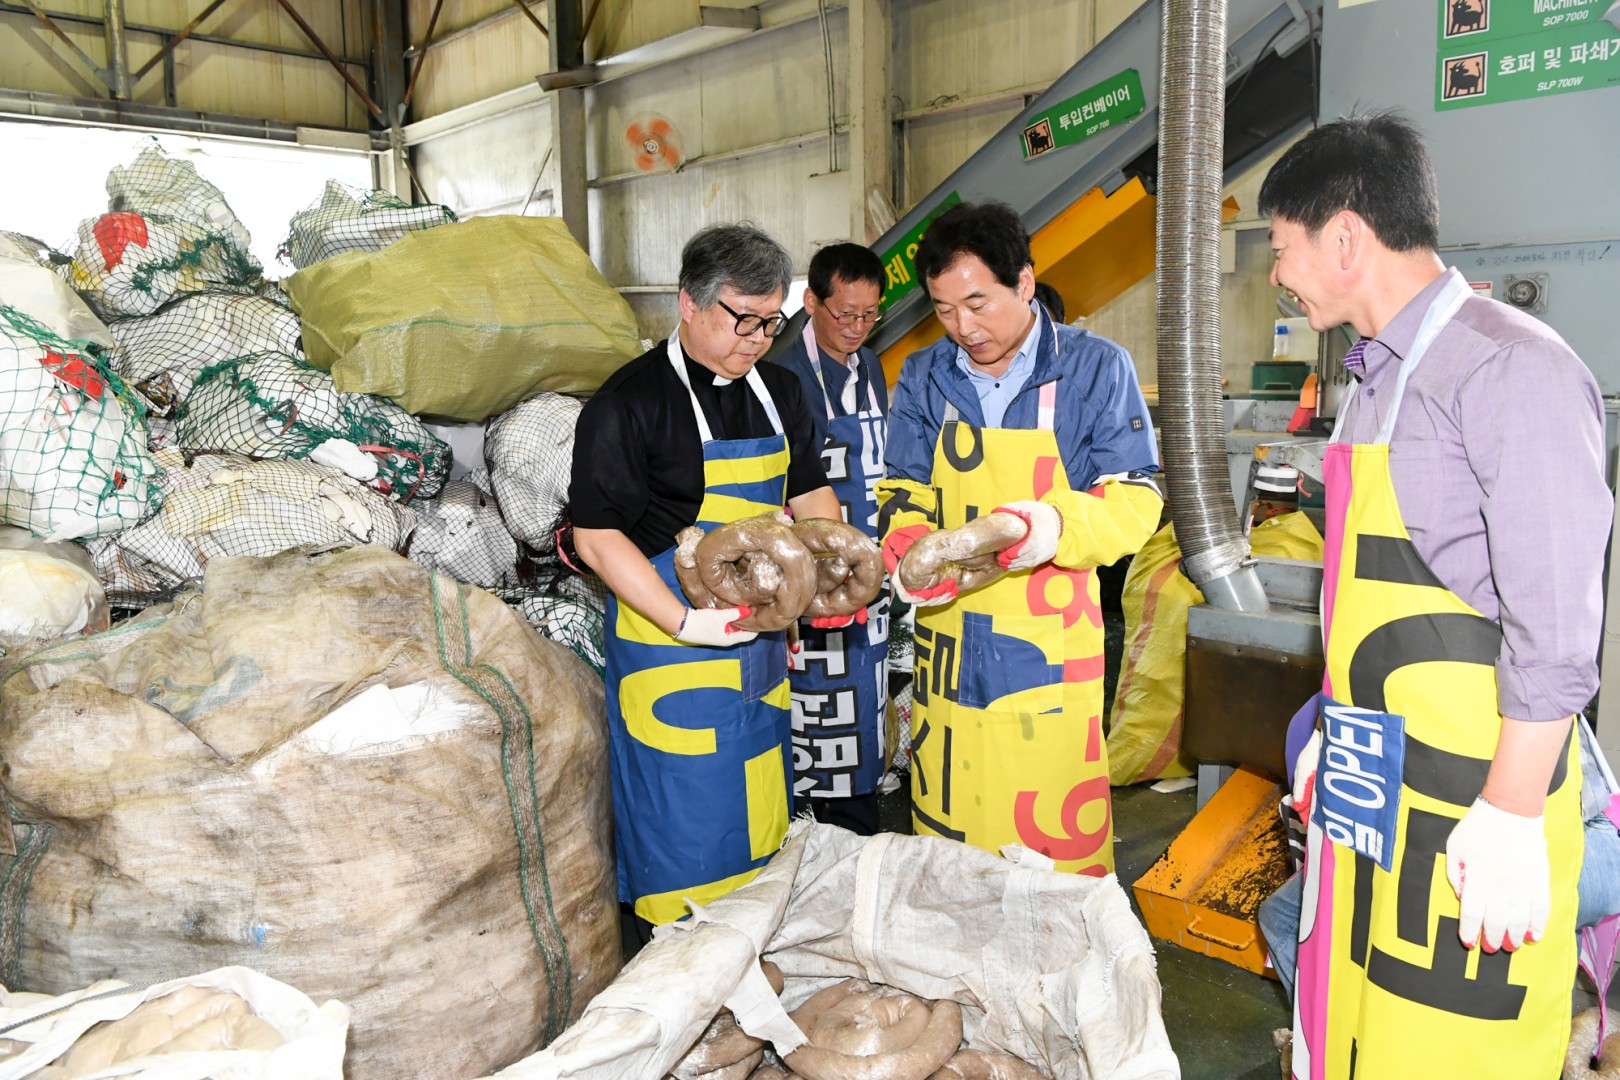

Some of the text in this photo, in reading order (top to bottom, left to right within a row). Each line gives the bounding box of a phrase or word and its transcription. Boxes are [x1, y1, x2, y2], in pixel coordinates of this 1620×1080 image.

[1542, 10, 1589, 27] SOP 7000
[1498, 51, 1536, 76] 호퍼
[1543, 46, 1562, 70] 및
[1537, 76, 1584, 91] SLP 700W
[1059, 85, 1131, 131] 투입컨베이어
[1086, 119, 1110, 136] SOP 700
[1323, 705, 1387, 809] OPEN
